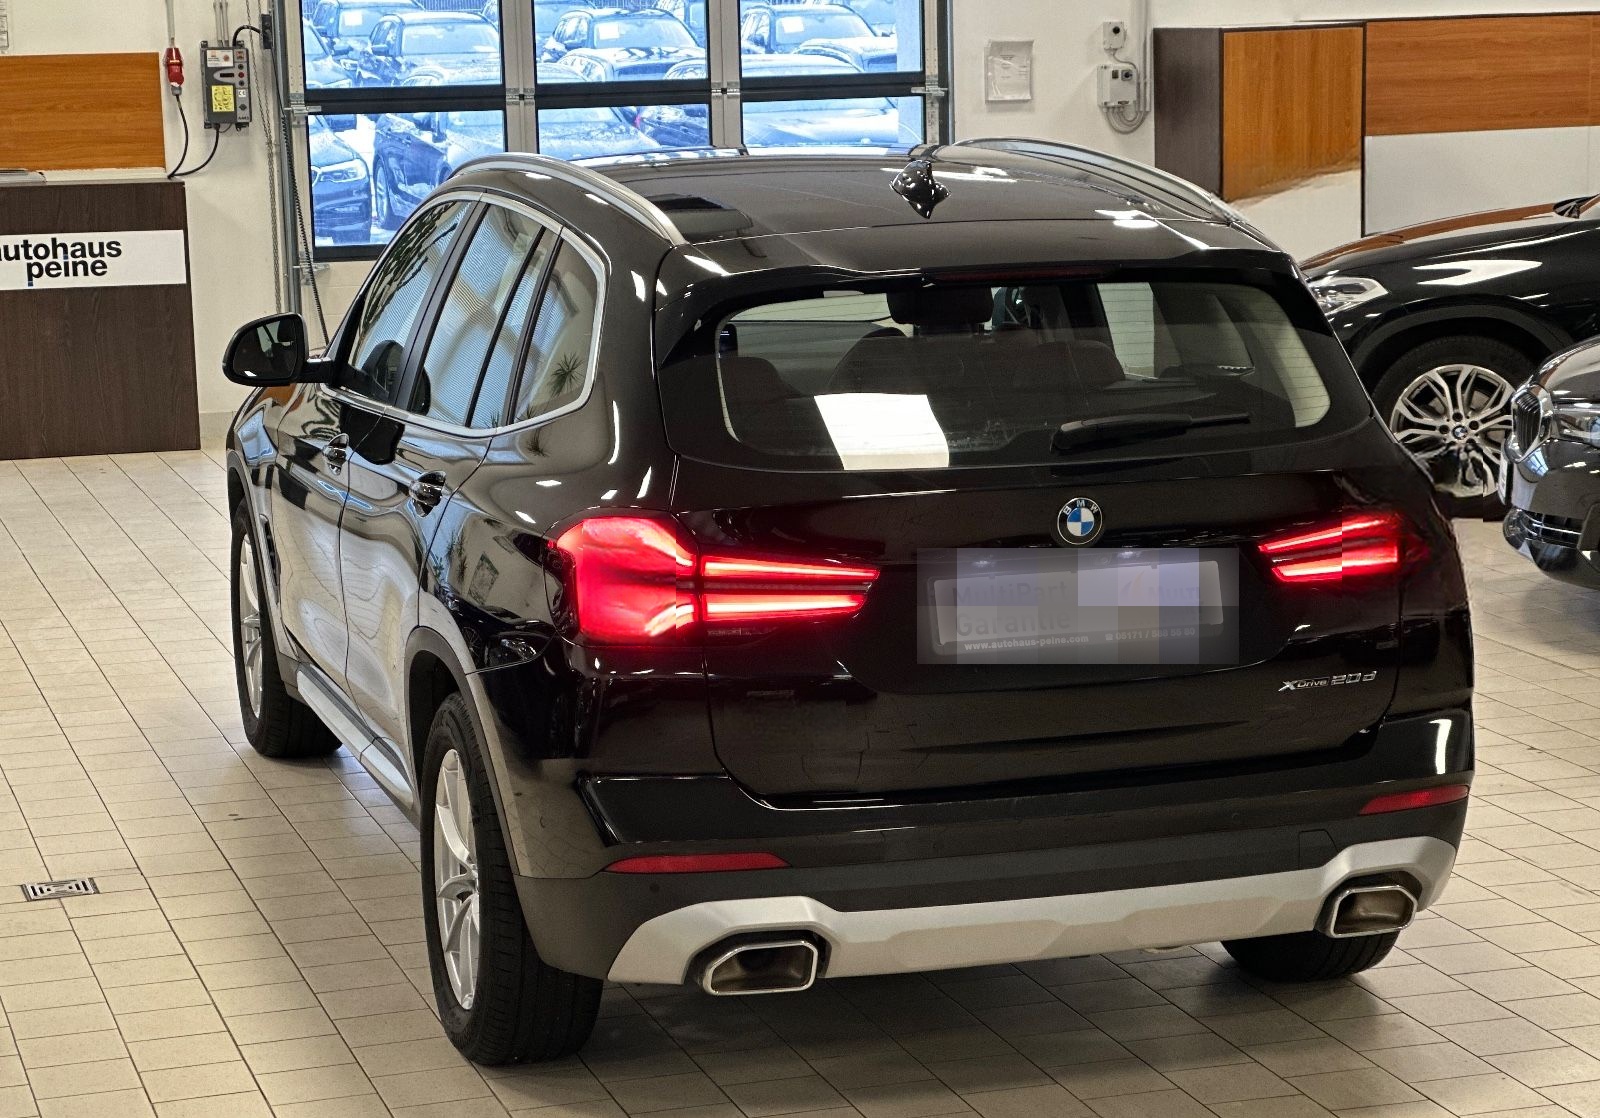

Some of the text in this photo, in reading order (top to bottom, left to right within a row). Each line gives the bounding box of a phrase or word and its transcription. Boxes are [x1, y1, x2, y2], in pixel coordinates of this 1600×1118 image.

[0, 237, 122, 262] utohaus
[26, 257, 108, 287] peine
[1062, 499, 1099, 516] BMW
[963, 635, 1089, 651] www.autohaus-peine.com
[1331, 670, 1377, 686] 20d
